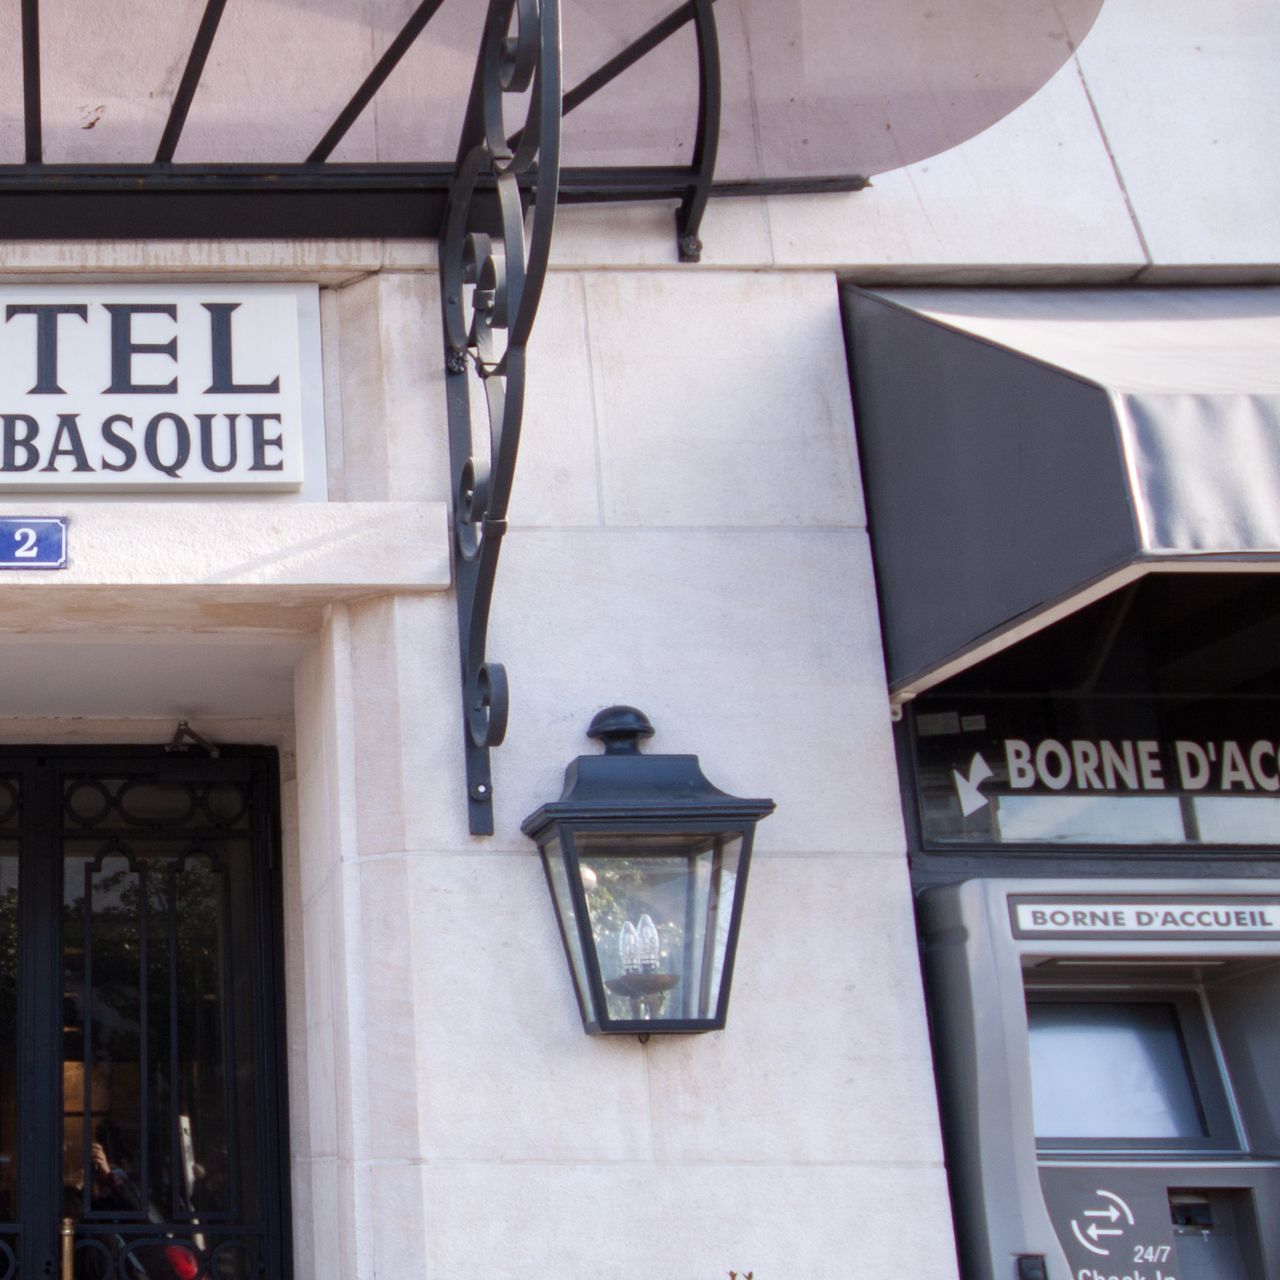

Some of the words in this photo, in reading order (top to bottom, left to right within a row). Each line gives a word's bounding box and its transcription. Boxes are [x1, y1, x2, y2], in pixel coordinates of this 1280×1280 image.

[13, 527, 39, 559] 2
[1004, 739, 1166, 791] BORNE
[1175, 739, 1280, 792] D'AC
[1031, 910, 1127, 927] BORNE
[1136, 910, 1274, 927] D'ACCUEIL
[1133, 1245, 1172, 1263] 24/7
